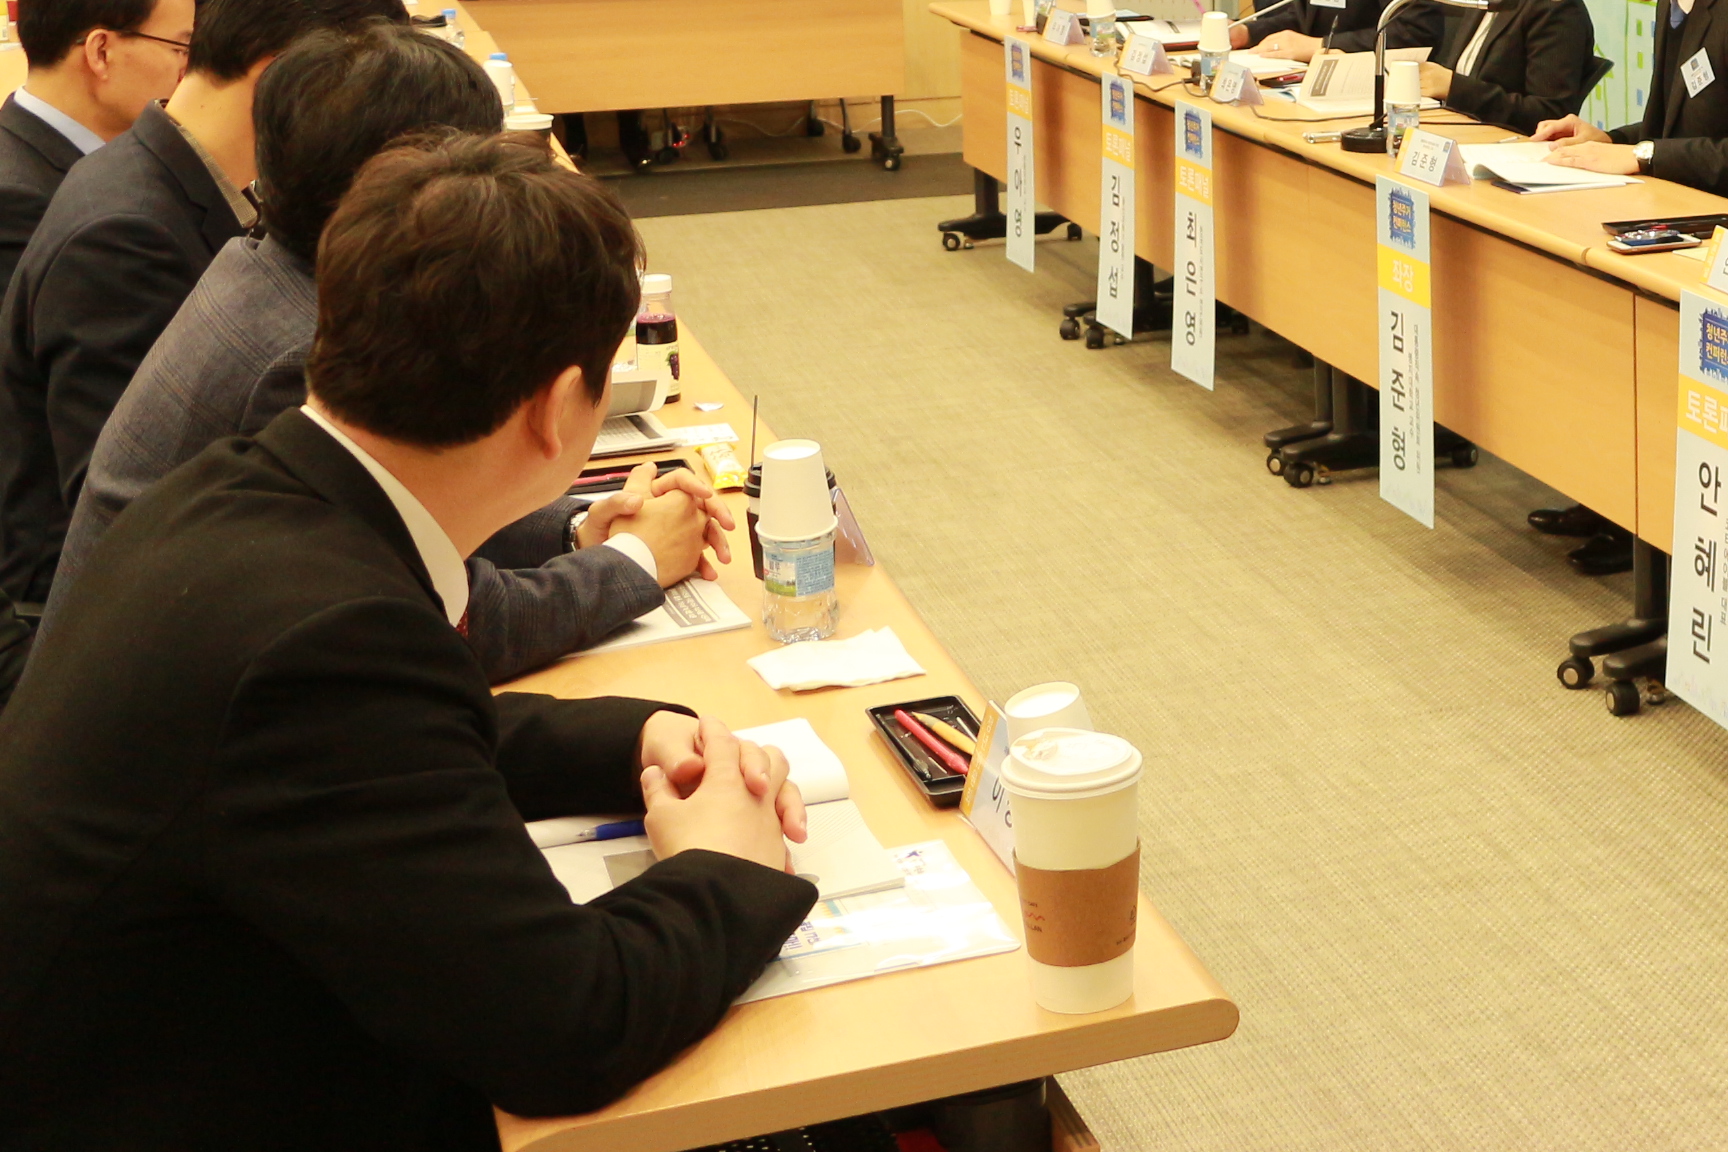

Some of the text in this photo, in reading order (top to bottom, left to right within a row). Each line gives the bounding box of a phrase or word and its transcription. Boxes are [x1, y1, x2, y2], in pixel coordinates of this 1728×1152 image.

[1107, 175, 1121, 300] 김정섭
[1184, 211, 1198, 347] 최은영
[1392, 260, 1414, 293] 좌장
[1390, 310, 1406, 472] 김준형
[1690, 461, 1722, 665] 안혜린
